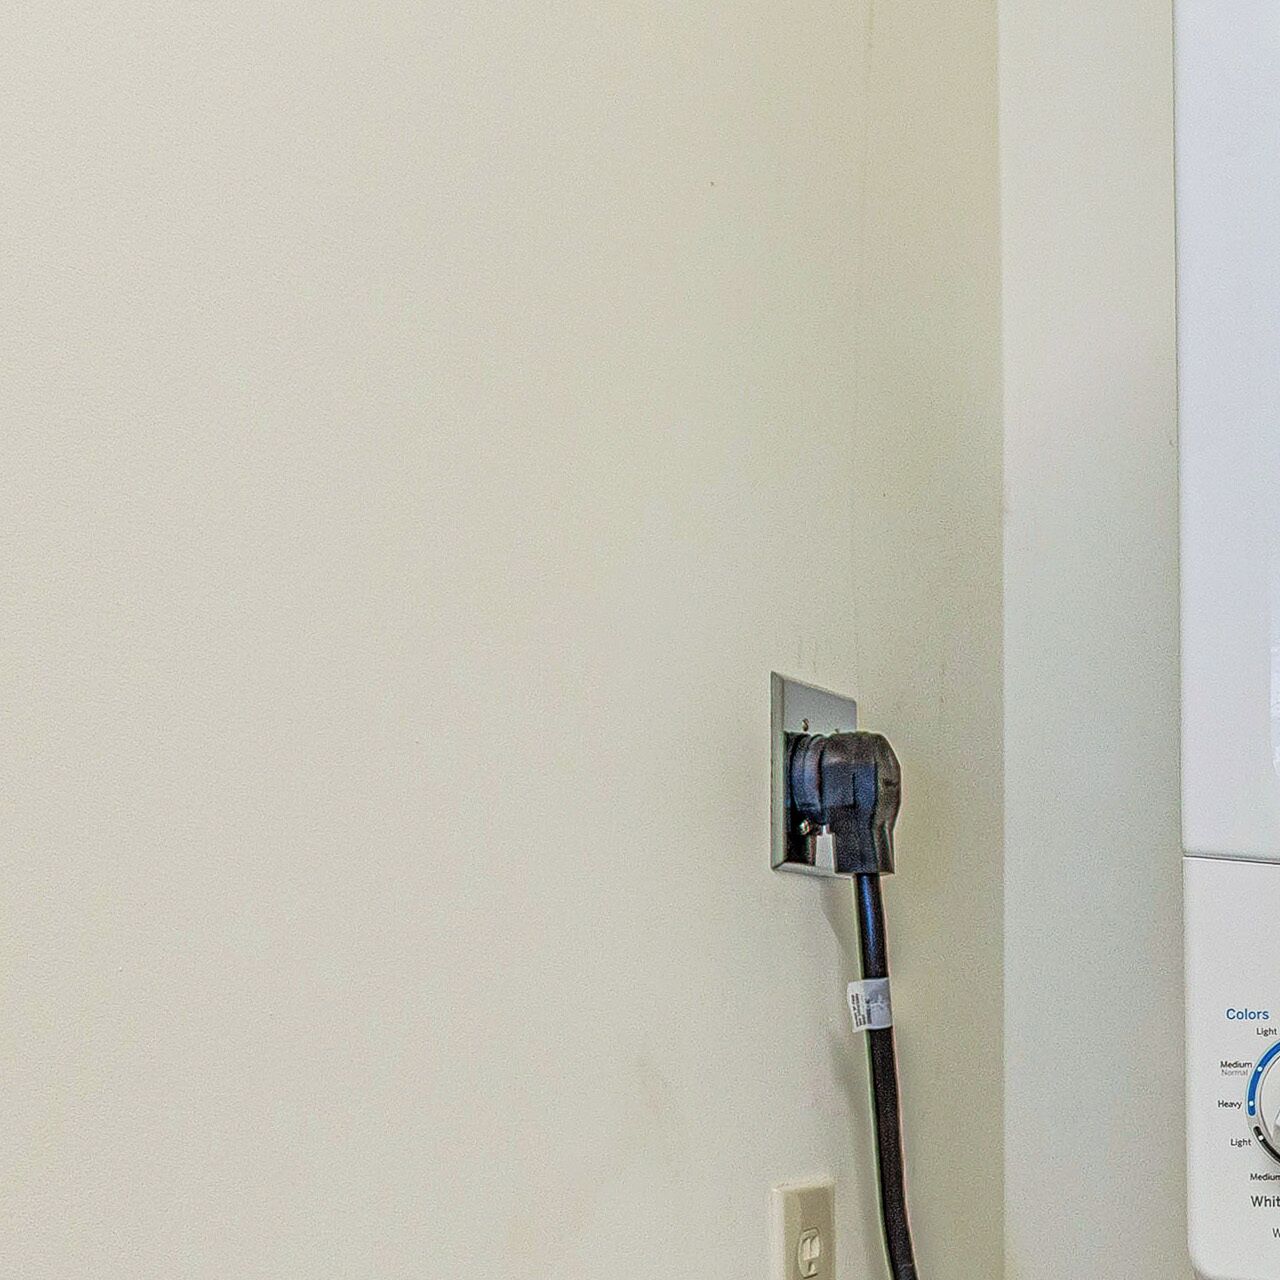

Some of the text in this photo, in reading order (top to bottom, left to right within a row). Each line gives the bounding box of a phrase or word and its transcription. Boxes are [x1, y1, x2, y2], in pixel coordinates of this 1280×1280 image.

[1225, 1008, 1270, 1021] Colors
[1256, 1027, 1277, 1037] Light
[1220, 1060, 1253, 1069] Medium
[1217, 1100, 1243, 1110] Heavy
[1230, 1138, 1252, 1148] Light
